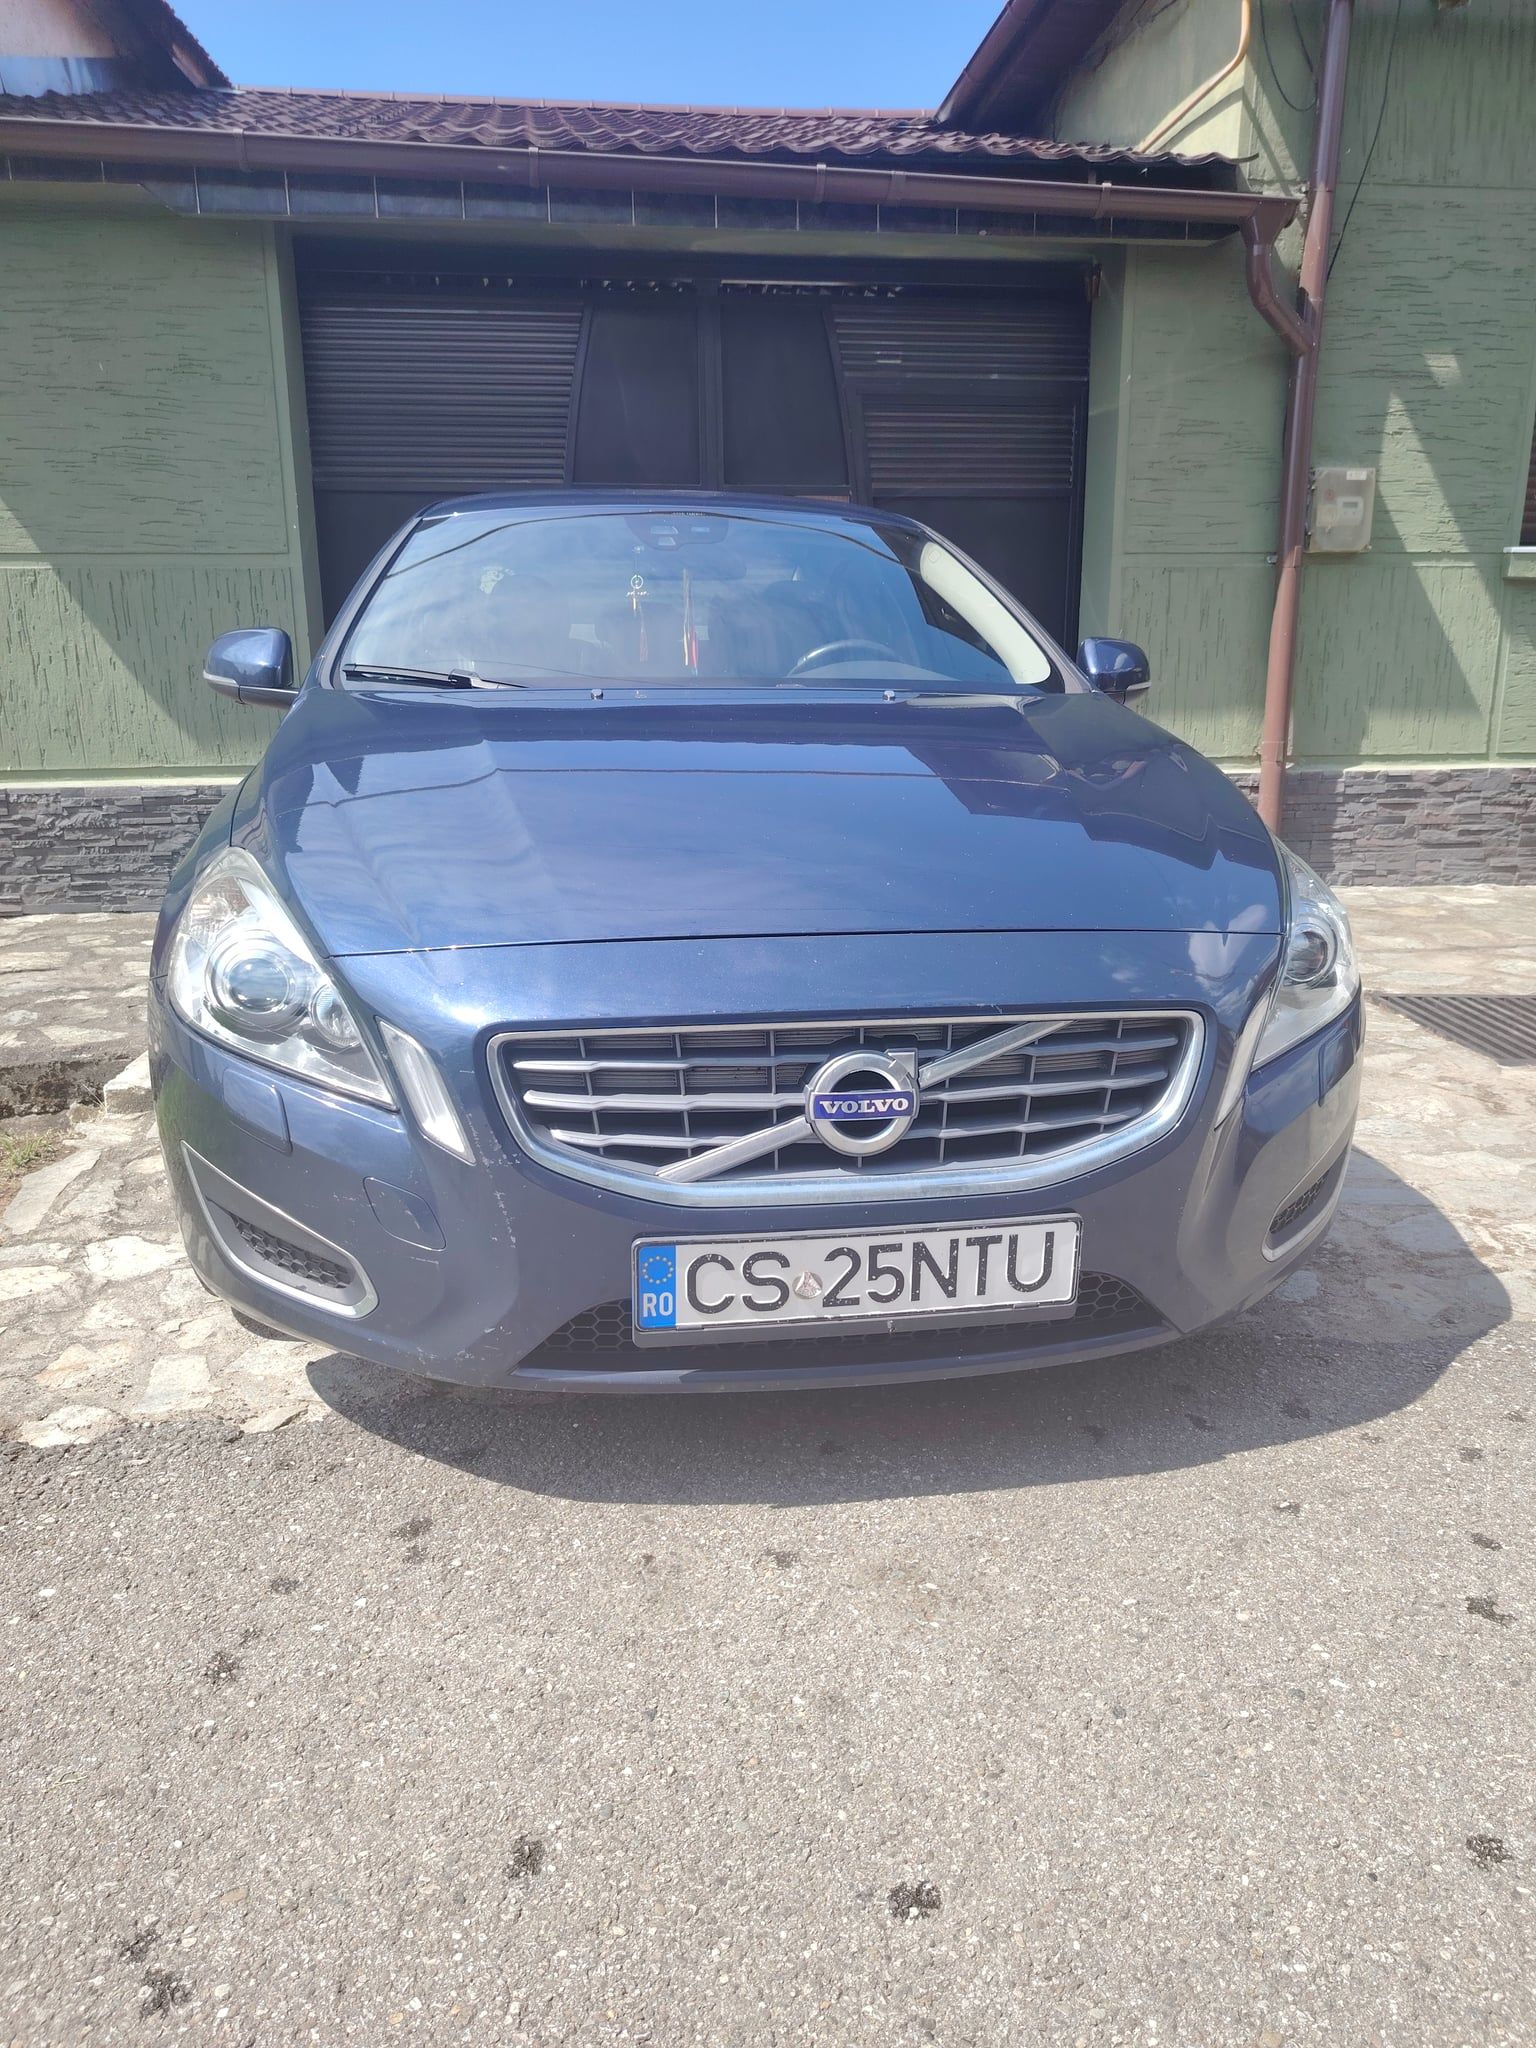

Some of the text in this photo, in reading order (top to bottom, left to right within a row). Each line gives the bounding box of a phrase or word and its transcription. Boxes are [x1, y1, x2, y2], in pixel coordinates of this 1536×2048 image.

[819, 1097, 909, 1114] VOLVO
[686, 1251, 791, 1315] CS
[642, 1291, 673, 1317] RO
